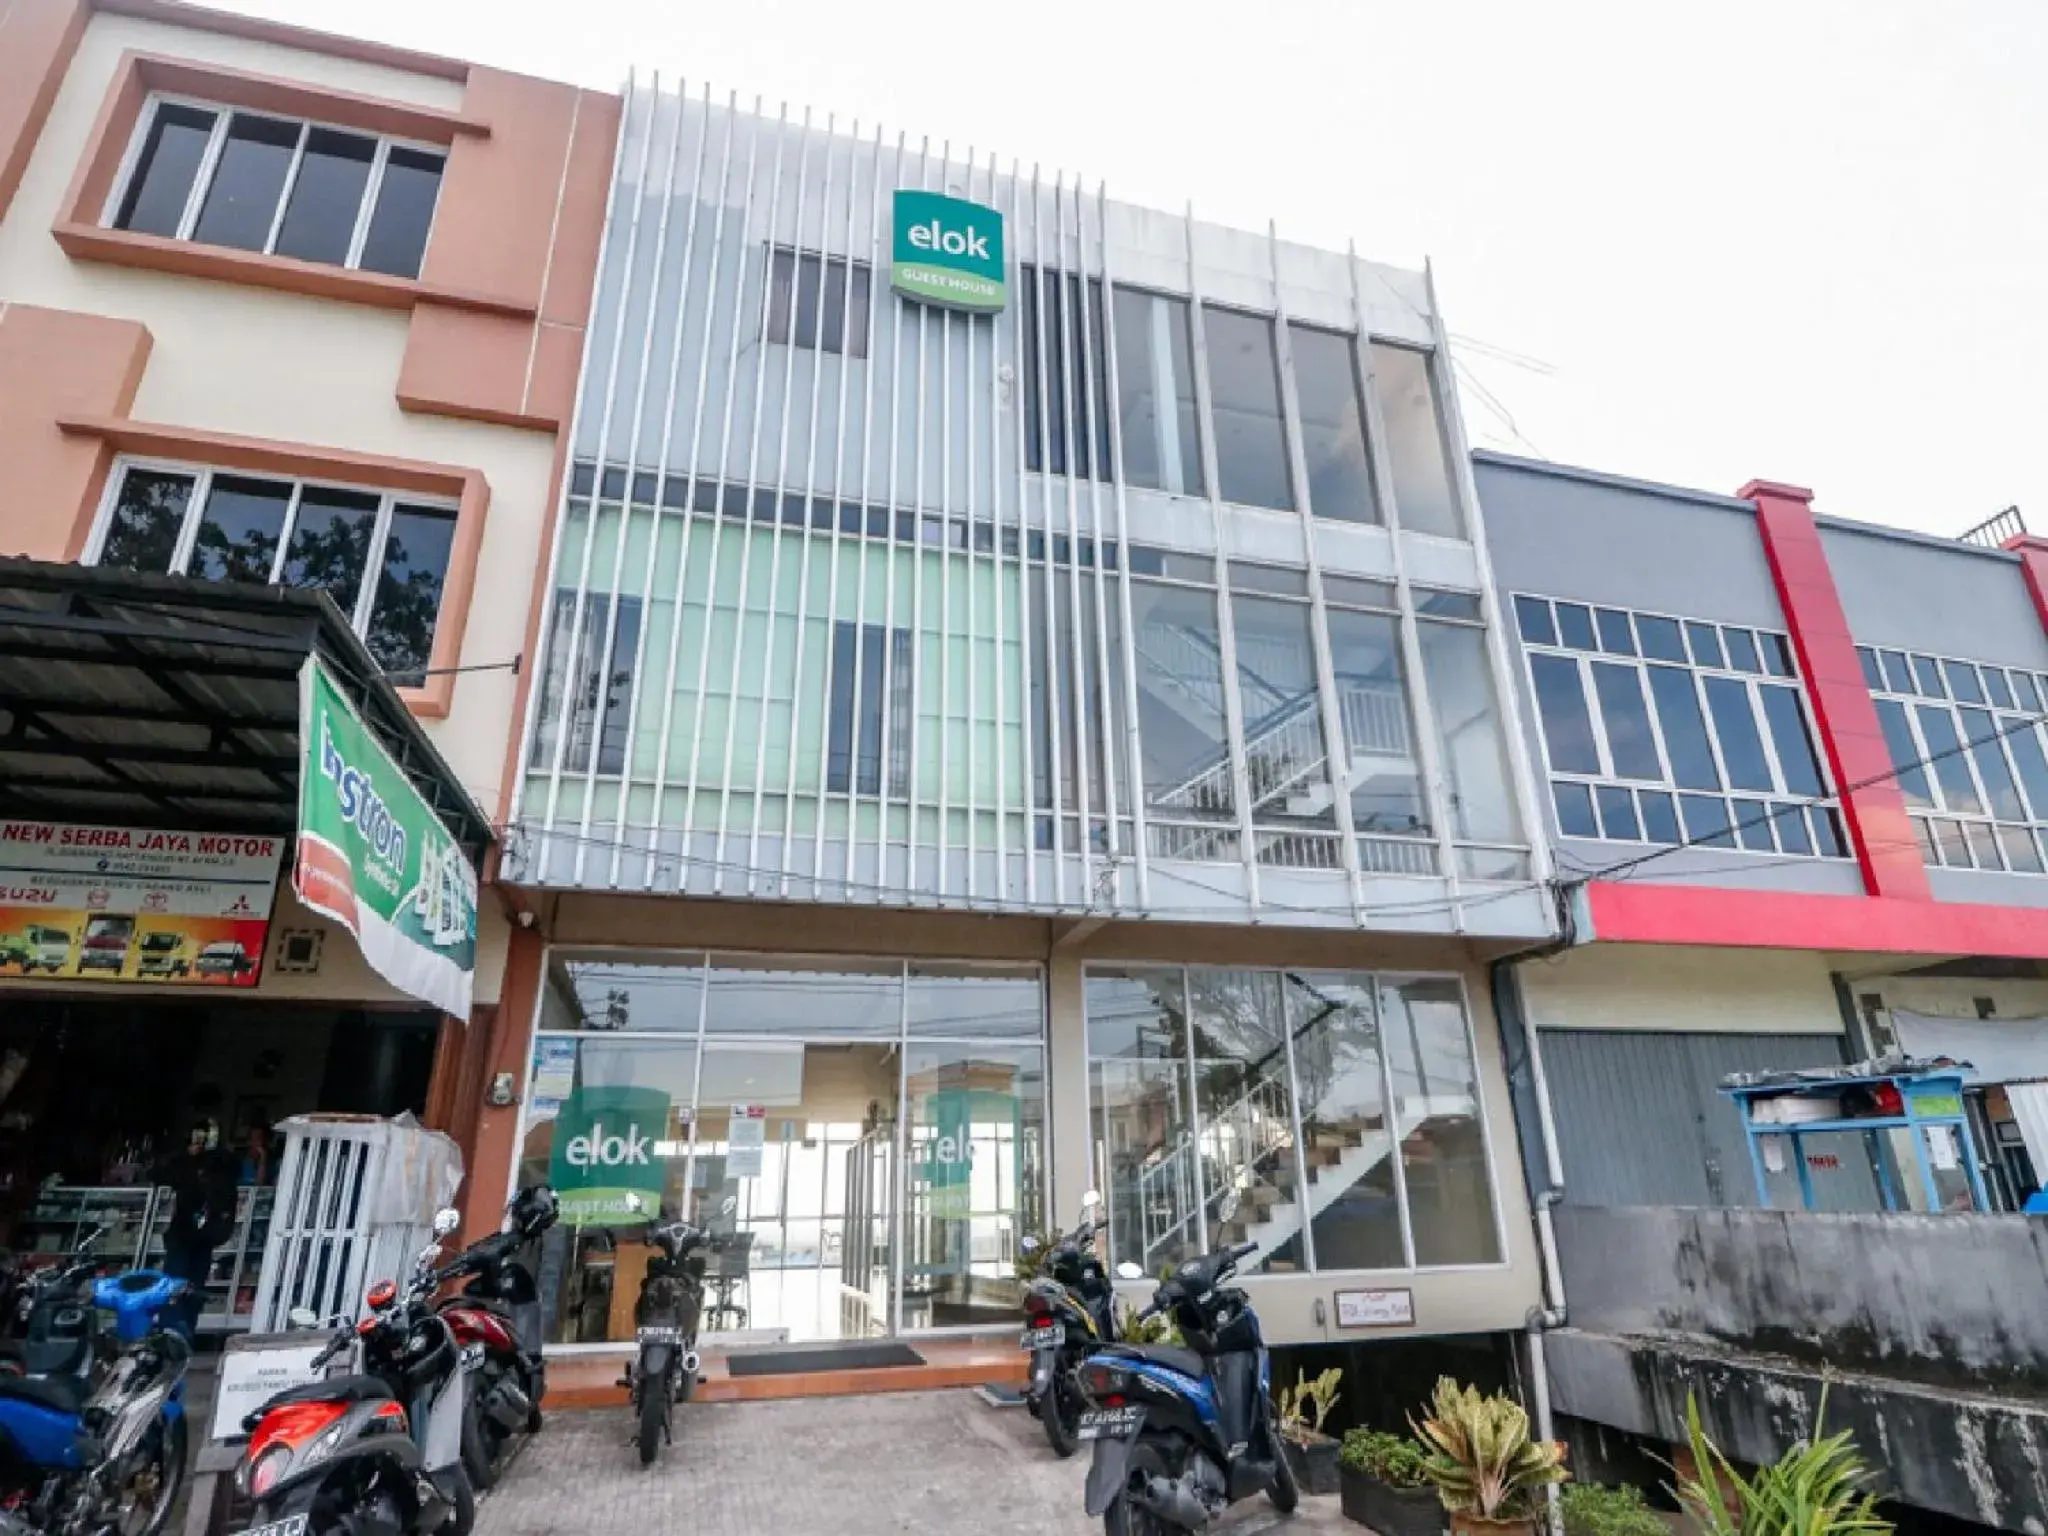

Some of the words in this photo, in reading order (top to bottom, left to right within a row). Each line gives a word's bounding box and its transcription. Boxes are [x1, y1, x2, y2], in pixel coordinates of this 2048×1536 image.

[908, 218, 990, 260] elok
[901, 268, 947, 287] GUEST
[948, 278, 996, 296] HOUSE
[321, 709, 406, 877] stron
[2, 824, 55, 844] NEW
[60, 828, 131, 848] SERBA
[138, 832, 190, 853] JAYA
[198, 837, 274, 856] MOTOR
[566, 1122, 652, 1165] elok
